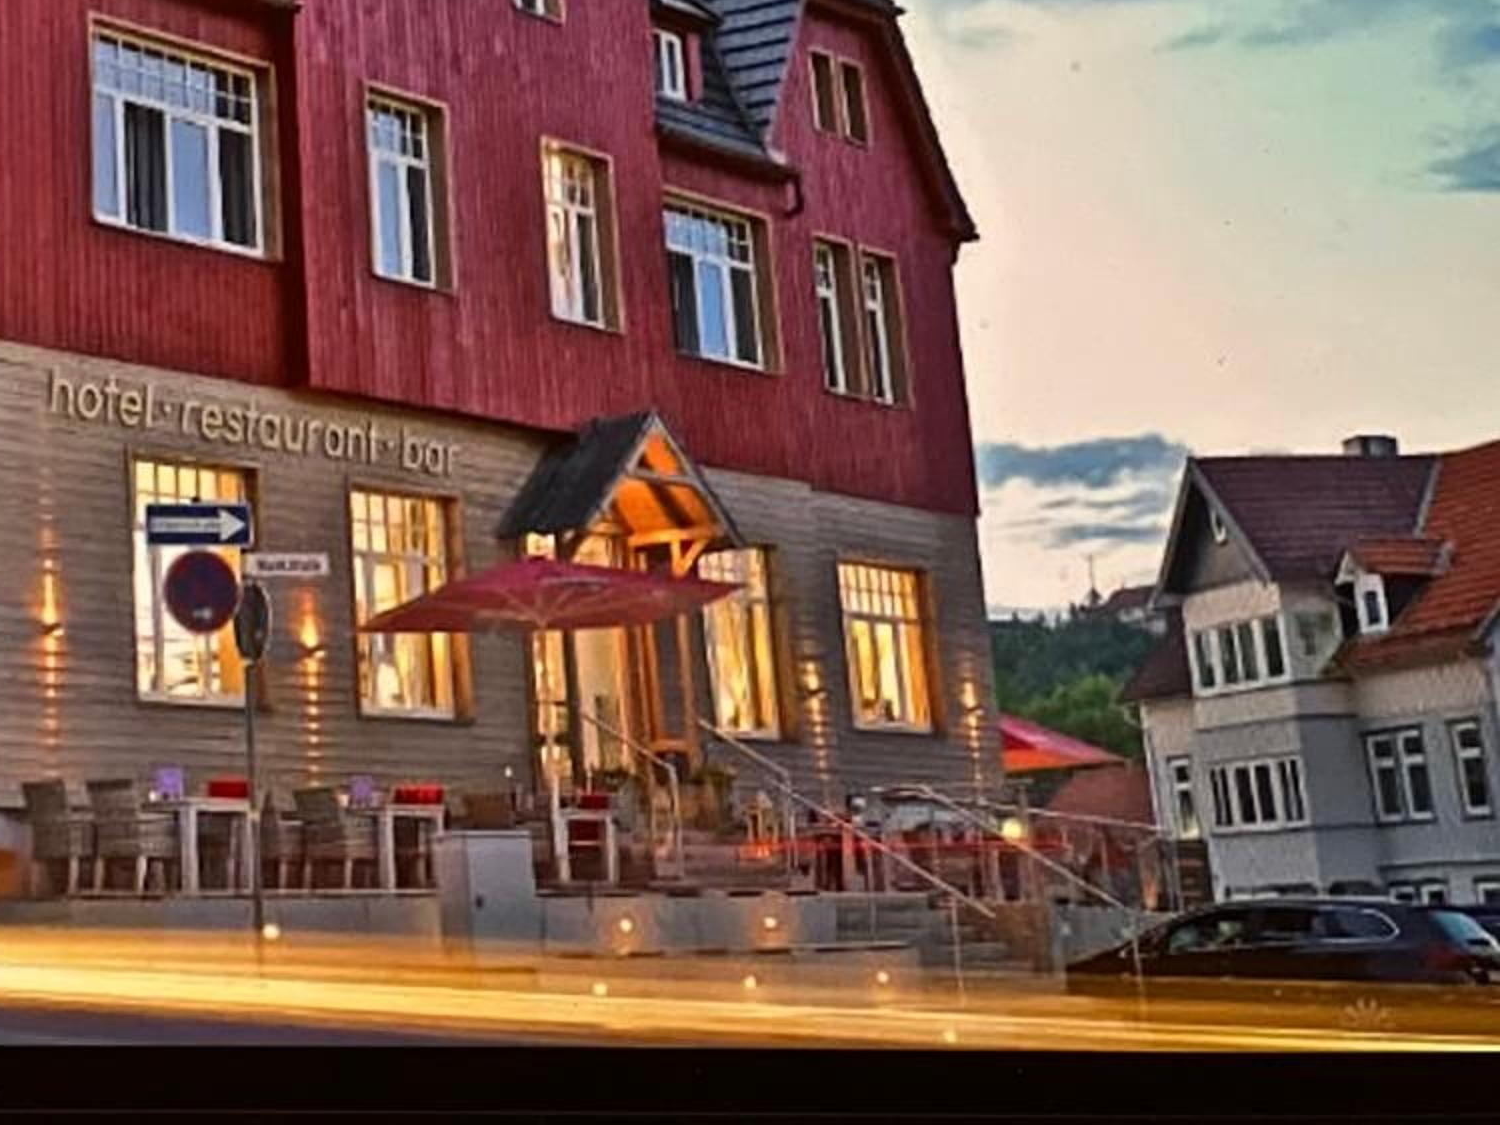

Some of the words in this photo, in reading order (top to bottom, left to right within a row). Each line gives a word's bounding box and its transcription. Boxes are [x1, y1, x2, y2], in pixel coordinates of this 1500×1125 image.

[50, 368, 155, 429] hotel
[182, 396, 380, 465] restaurant
[402, 426, 461, 475] bar
